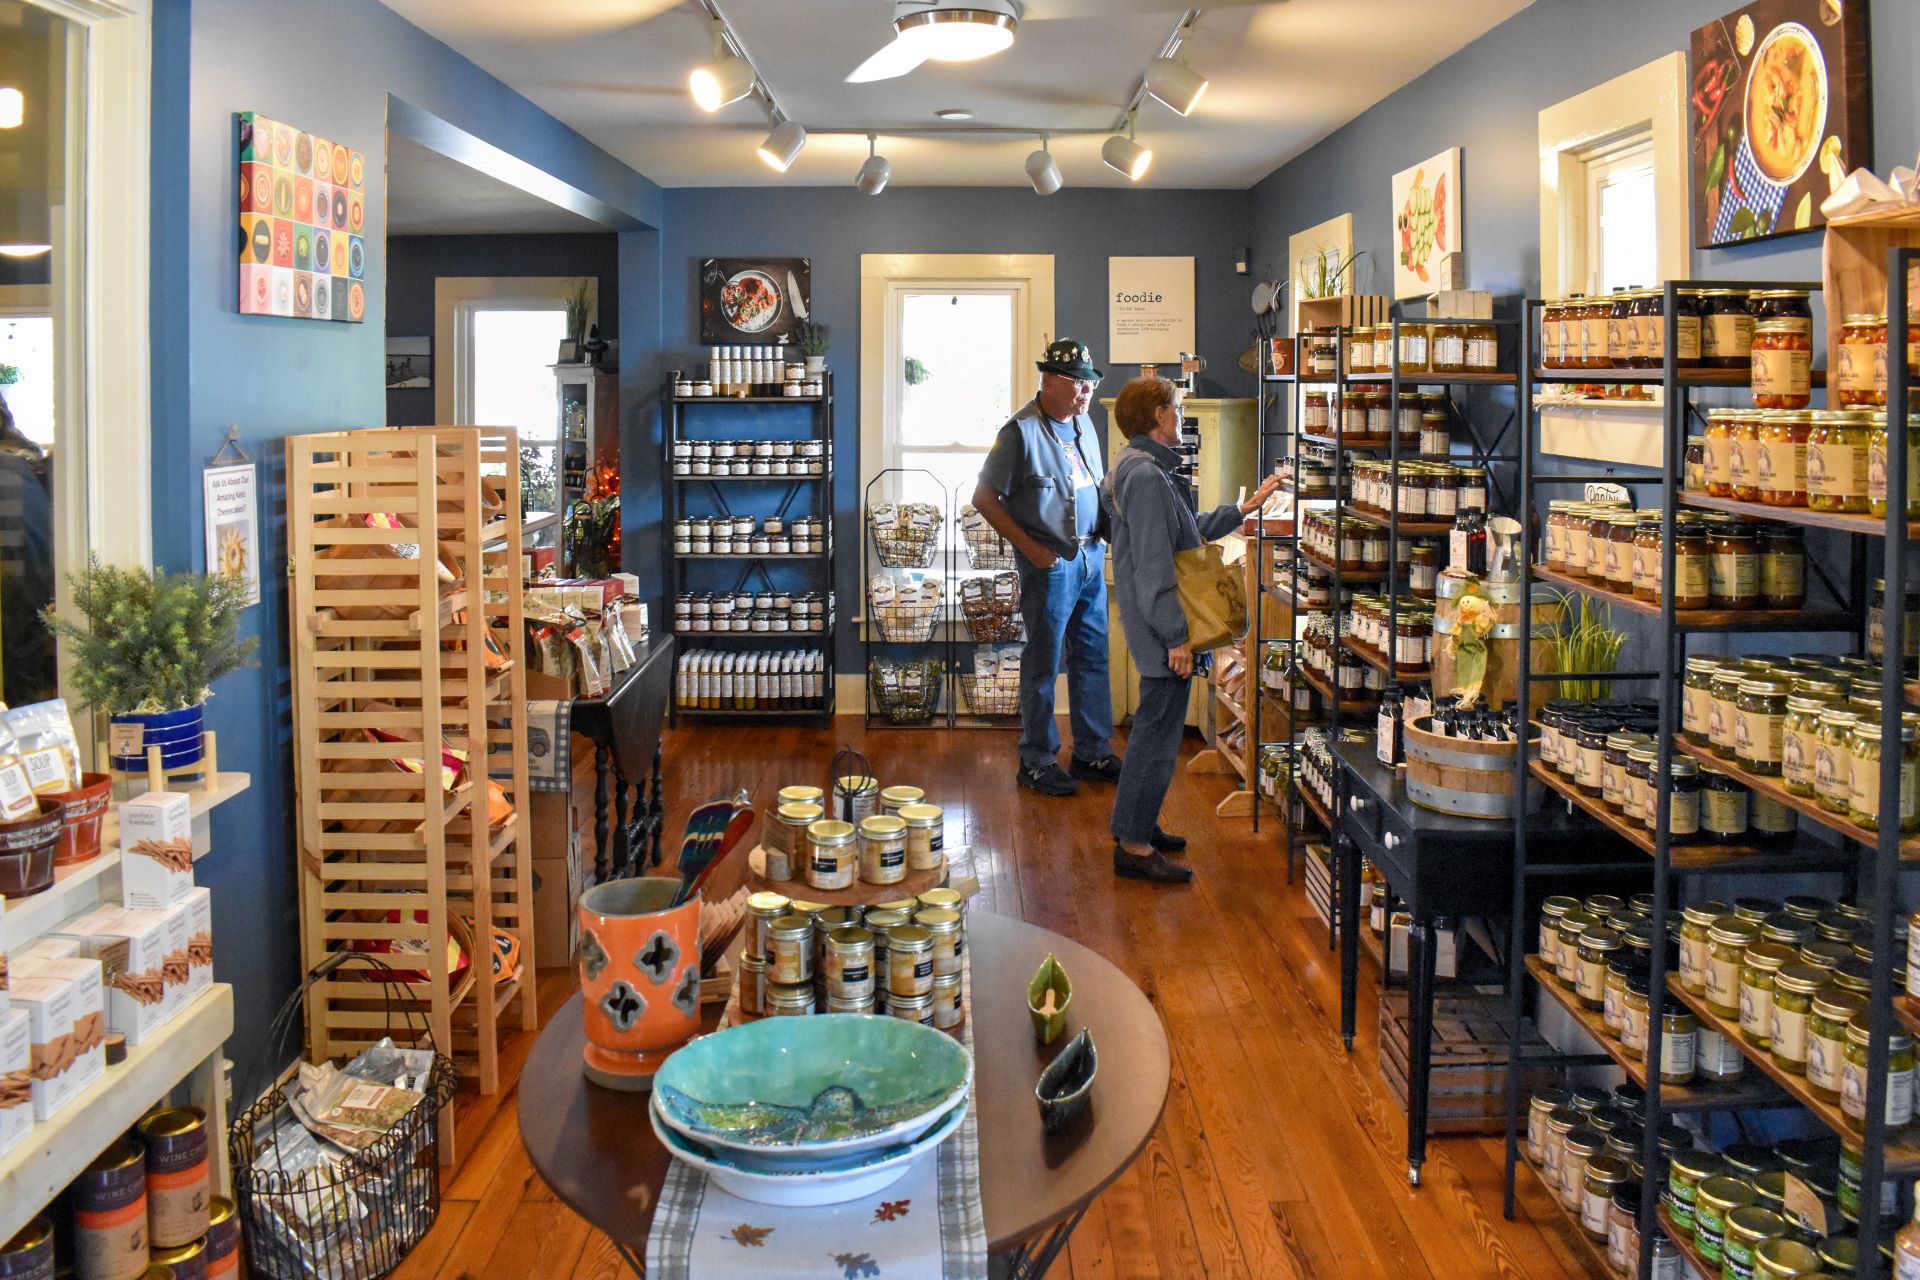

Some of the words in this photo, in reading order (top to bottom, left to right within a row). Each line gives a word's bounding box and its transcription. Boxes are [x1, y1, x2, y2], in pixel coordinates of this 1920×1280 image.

[1116, 292, 1163, 303] foodie
[212, 480, 221, 488] Ask
[227, 477, 241, 486] About
[241, 475, 249, 484] Our
[217, 490, 236, 501] Amazing
[236, 489, 246, 499] Keto
[29, 753, 51, 772] SOUP
[1, 769, 18, 787] SOUP
[159, 1151, 187, 1163] WINE
[96, 1187, 125, 1201] WINE
